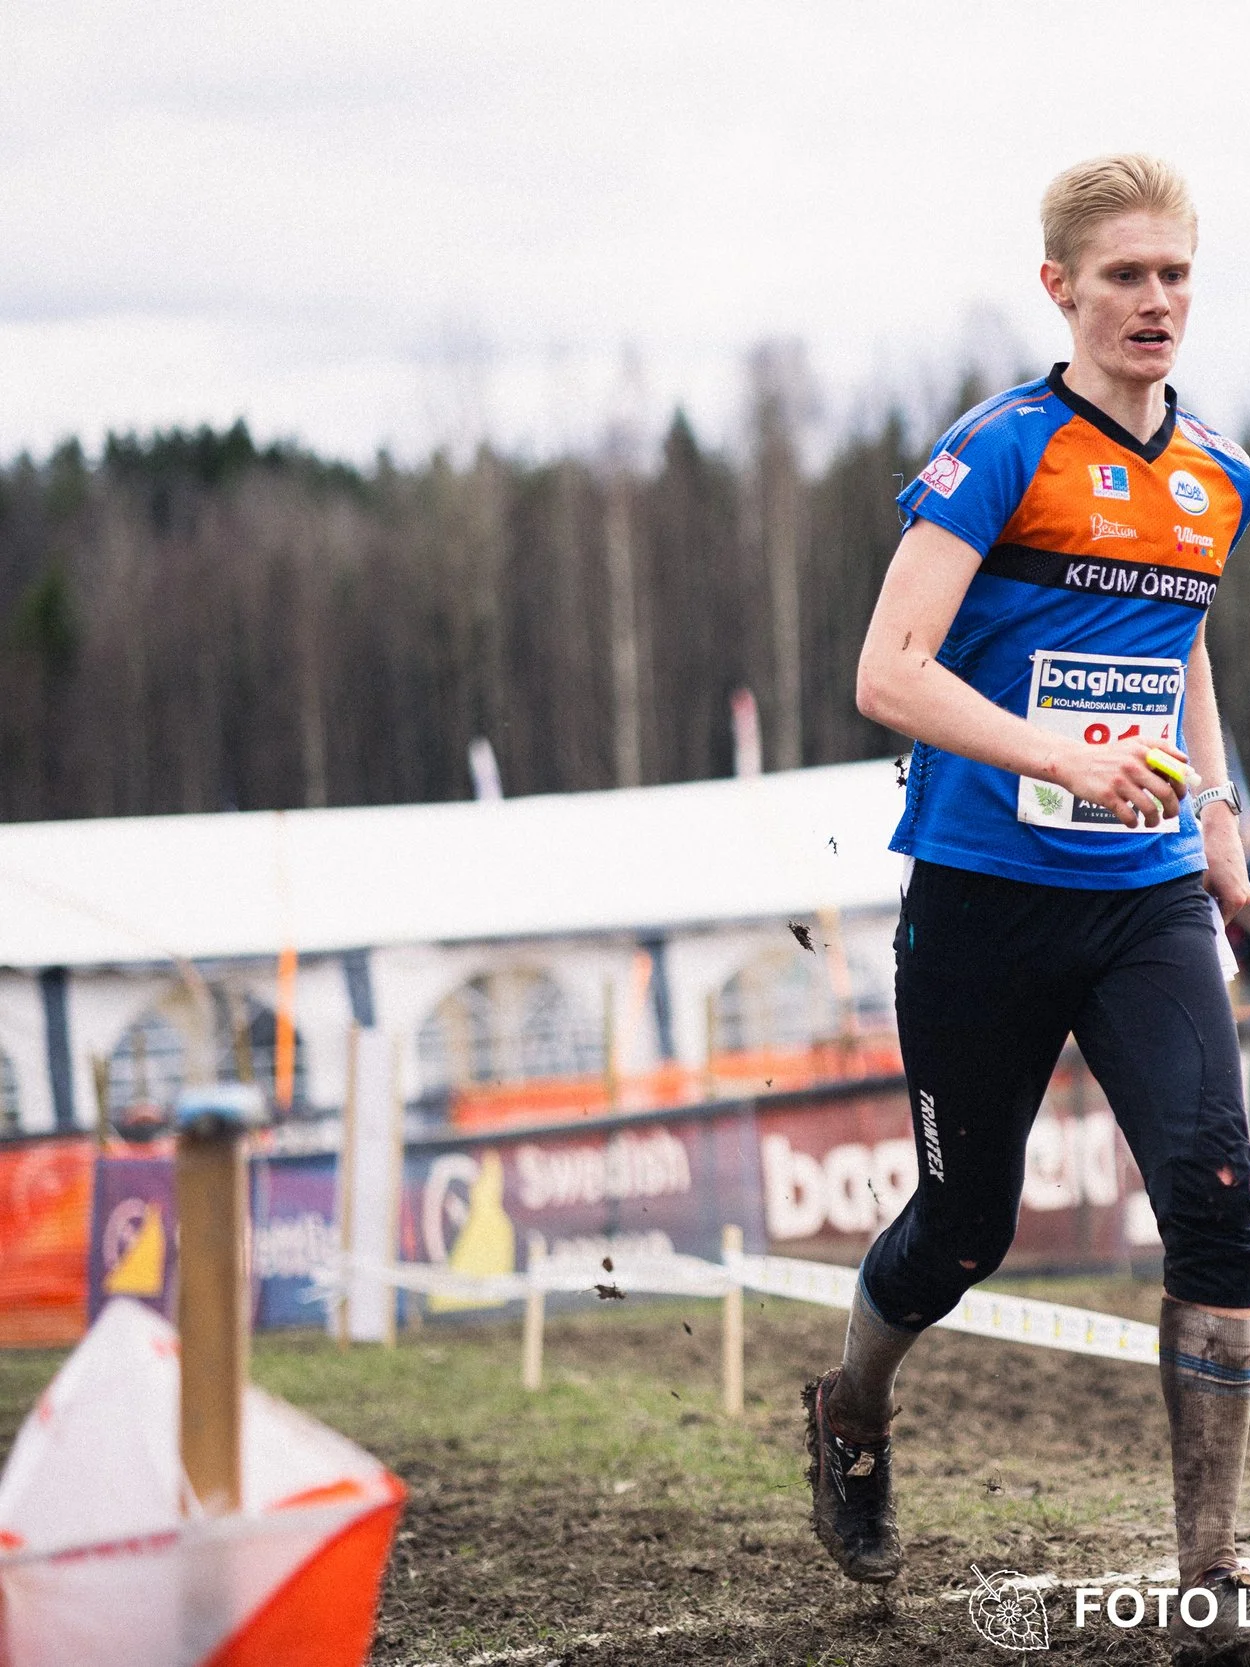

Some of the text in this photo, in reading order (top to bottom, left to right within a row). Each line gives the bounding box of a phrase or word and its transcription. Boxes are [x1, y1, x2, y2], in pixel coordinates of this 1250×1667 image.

[1065, 562, 1218, 606] KFUM ÖREBRO
[1041, 663, 1181, 697] bagheera
[1053, 697, 1126, 711] KOLMÅRDSKAVLEN
[1132, 703, 1145, 712] STL
[919, 1088, 945, 1183] TRIMTEX
